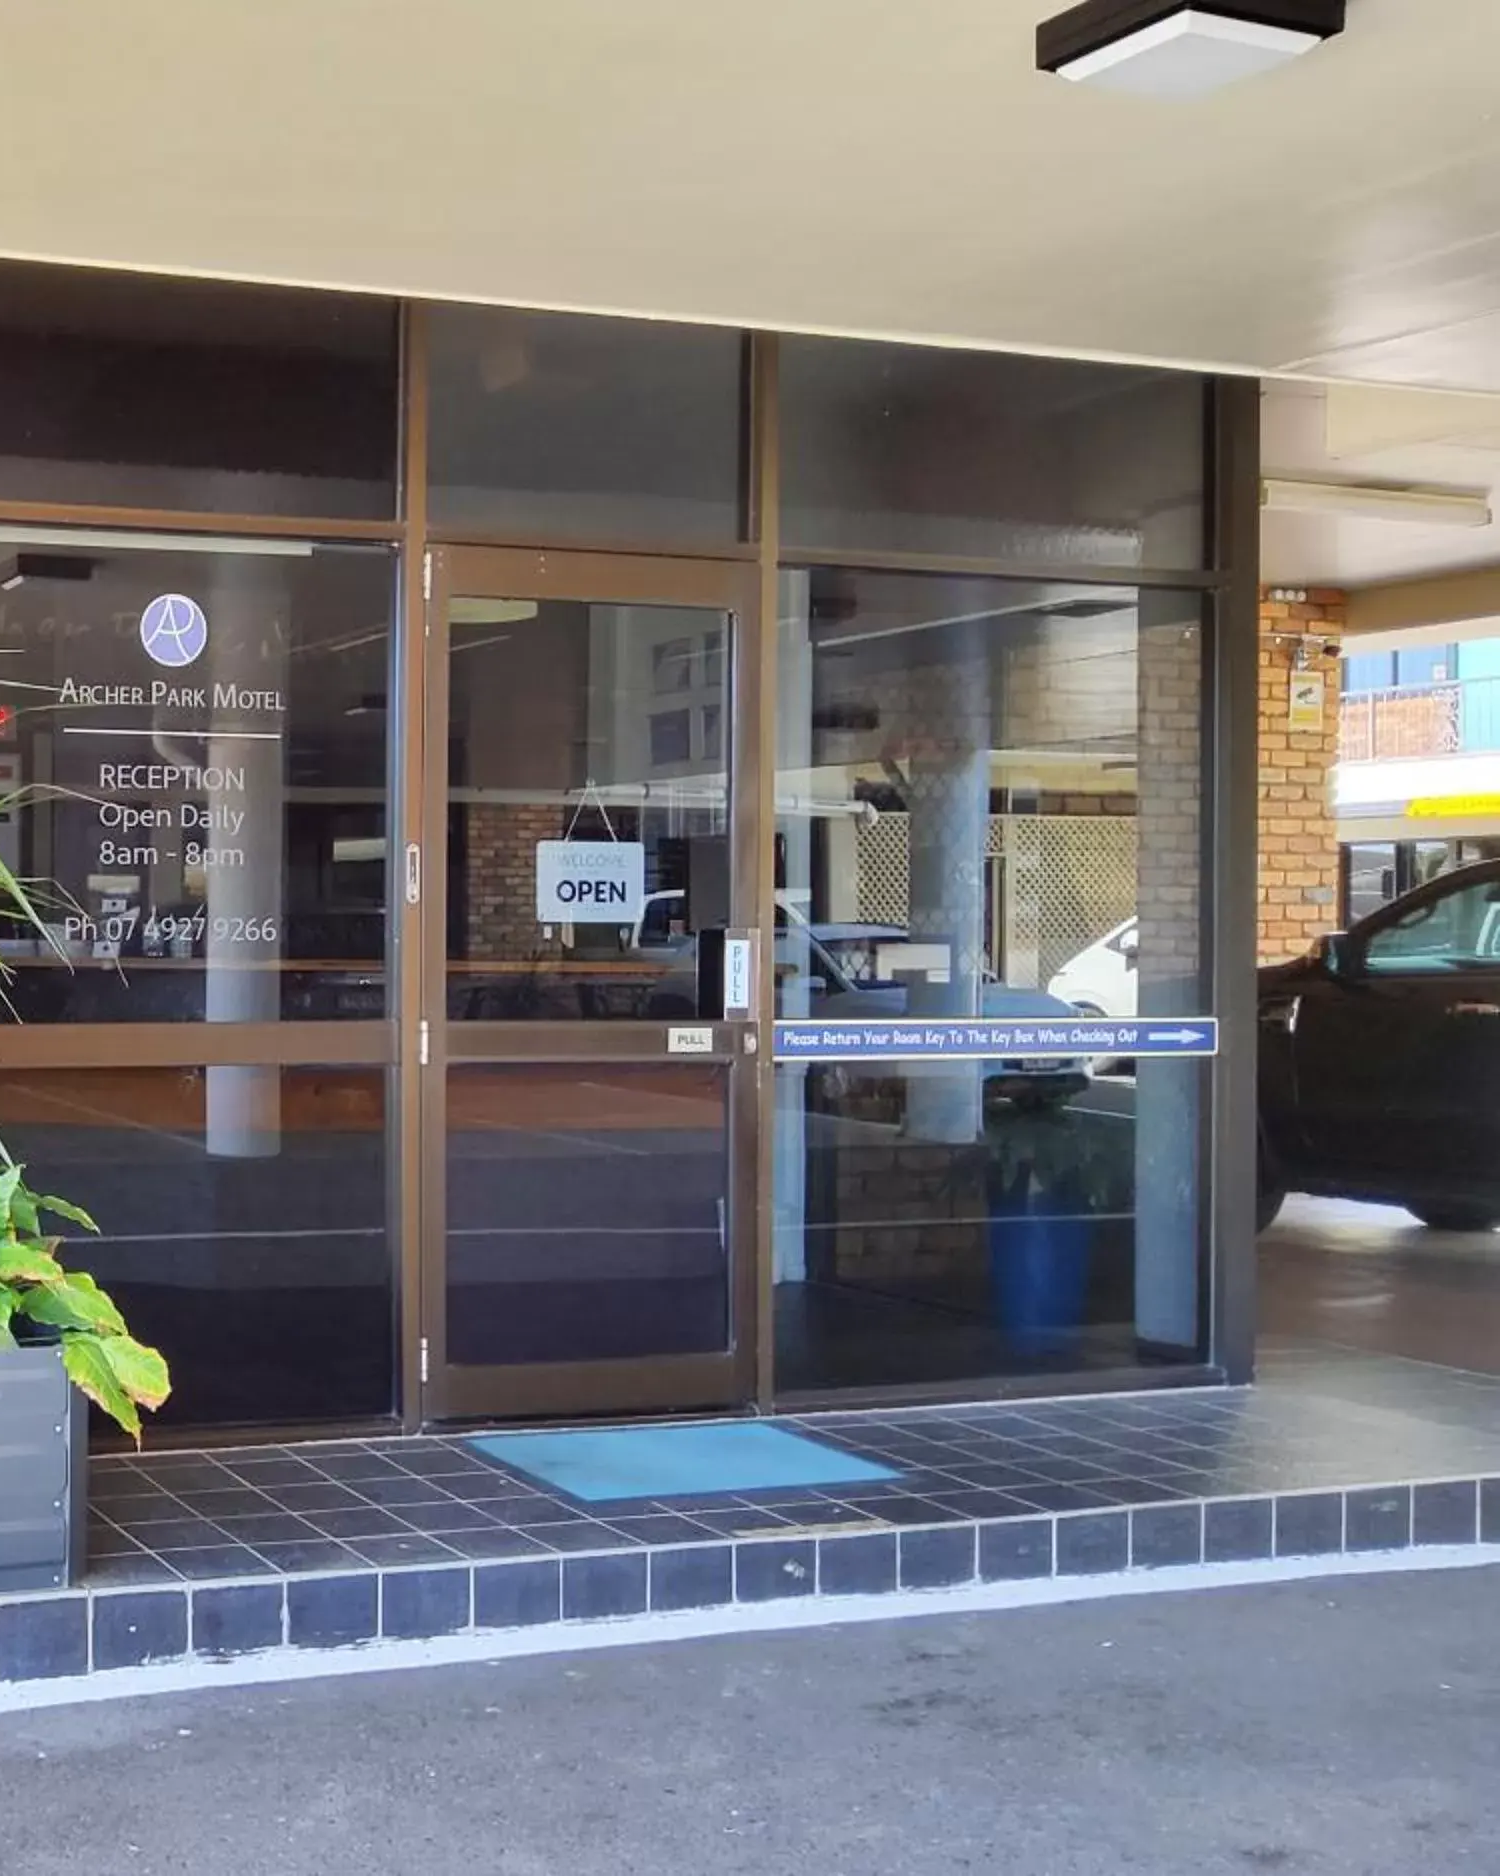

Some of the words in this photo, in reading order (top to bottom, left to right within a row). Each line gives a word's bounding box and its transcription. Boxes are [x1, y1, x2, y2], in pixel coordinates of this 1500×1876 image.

[59, 677, 143, 705] ARCHER
[151, 680, 207, 708] PARK
[212, 683, 287, 712] MOTEL
[100, 763, 245, 792] RECEPTION
[99, 803, 172, 832] Open
[180, 804, 245, 836] Daily
[99, 841, 159, 865] 8am
[185, 842, 244, 872] 8pm
[556, 879, 628, 904] OPEN
[64, 917, 98, 941] Ph
[105, 918, 139, 941] 07
[143, 917, 205, 942] 4927
[212, 917, 278, 942] 9266
[733, 945, 742, 1004] PULL
[677, 1034, 706, 1046] PULL
[783, 1031, 819, 1046] Please
[823, 1030, 861, 1046] Return
[863, 1029, 890, 1045] Your
[893, 1030, 922, 1045] Room
[925, 1029, 946, 1048] Key
[949, 1029, 964, 1045] To
[967, 1029, 987, 1044] The
[991, 1028, 1011, 1048] Key
[1013, 1028, 1035, 1044] Box
[1037, 1028, 1068, 1044] When
[1071, 1028, 1115, 1047] Checking
[1117, 1028, 1139, 1043] Out
